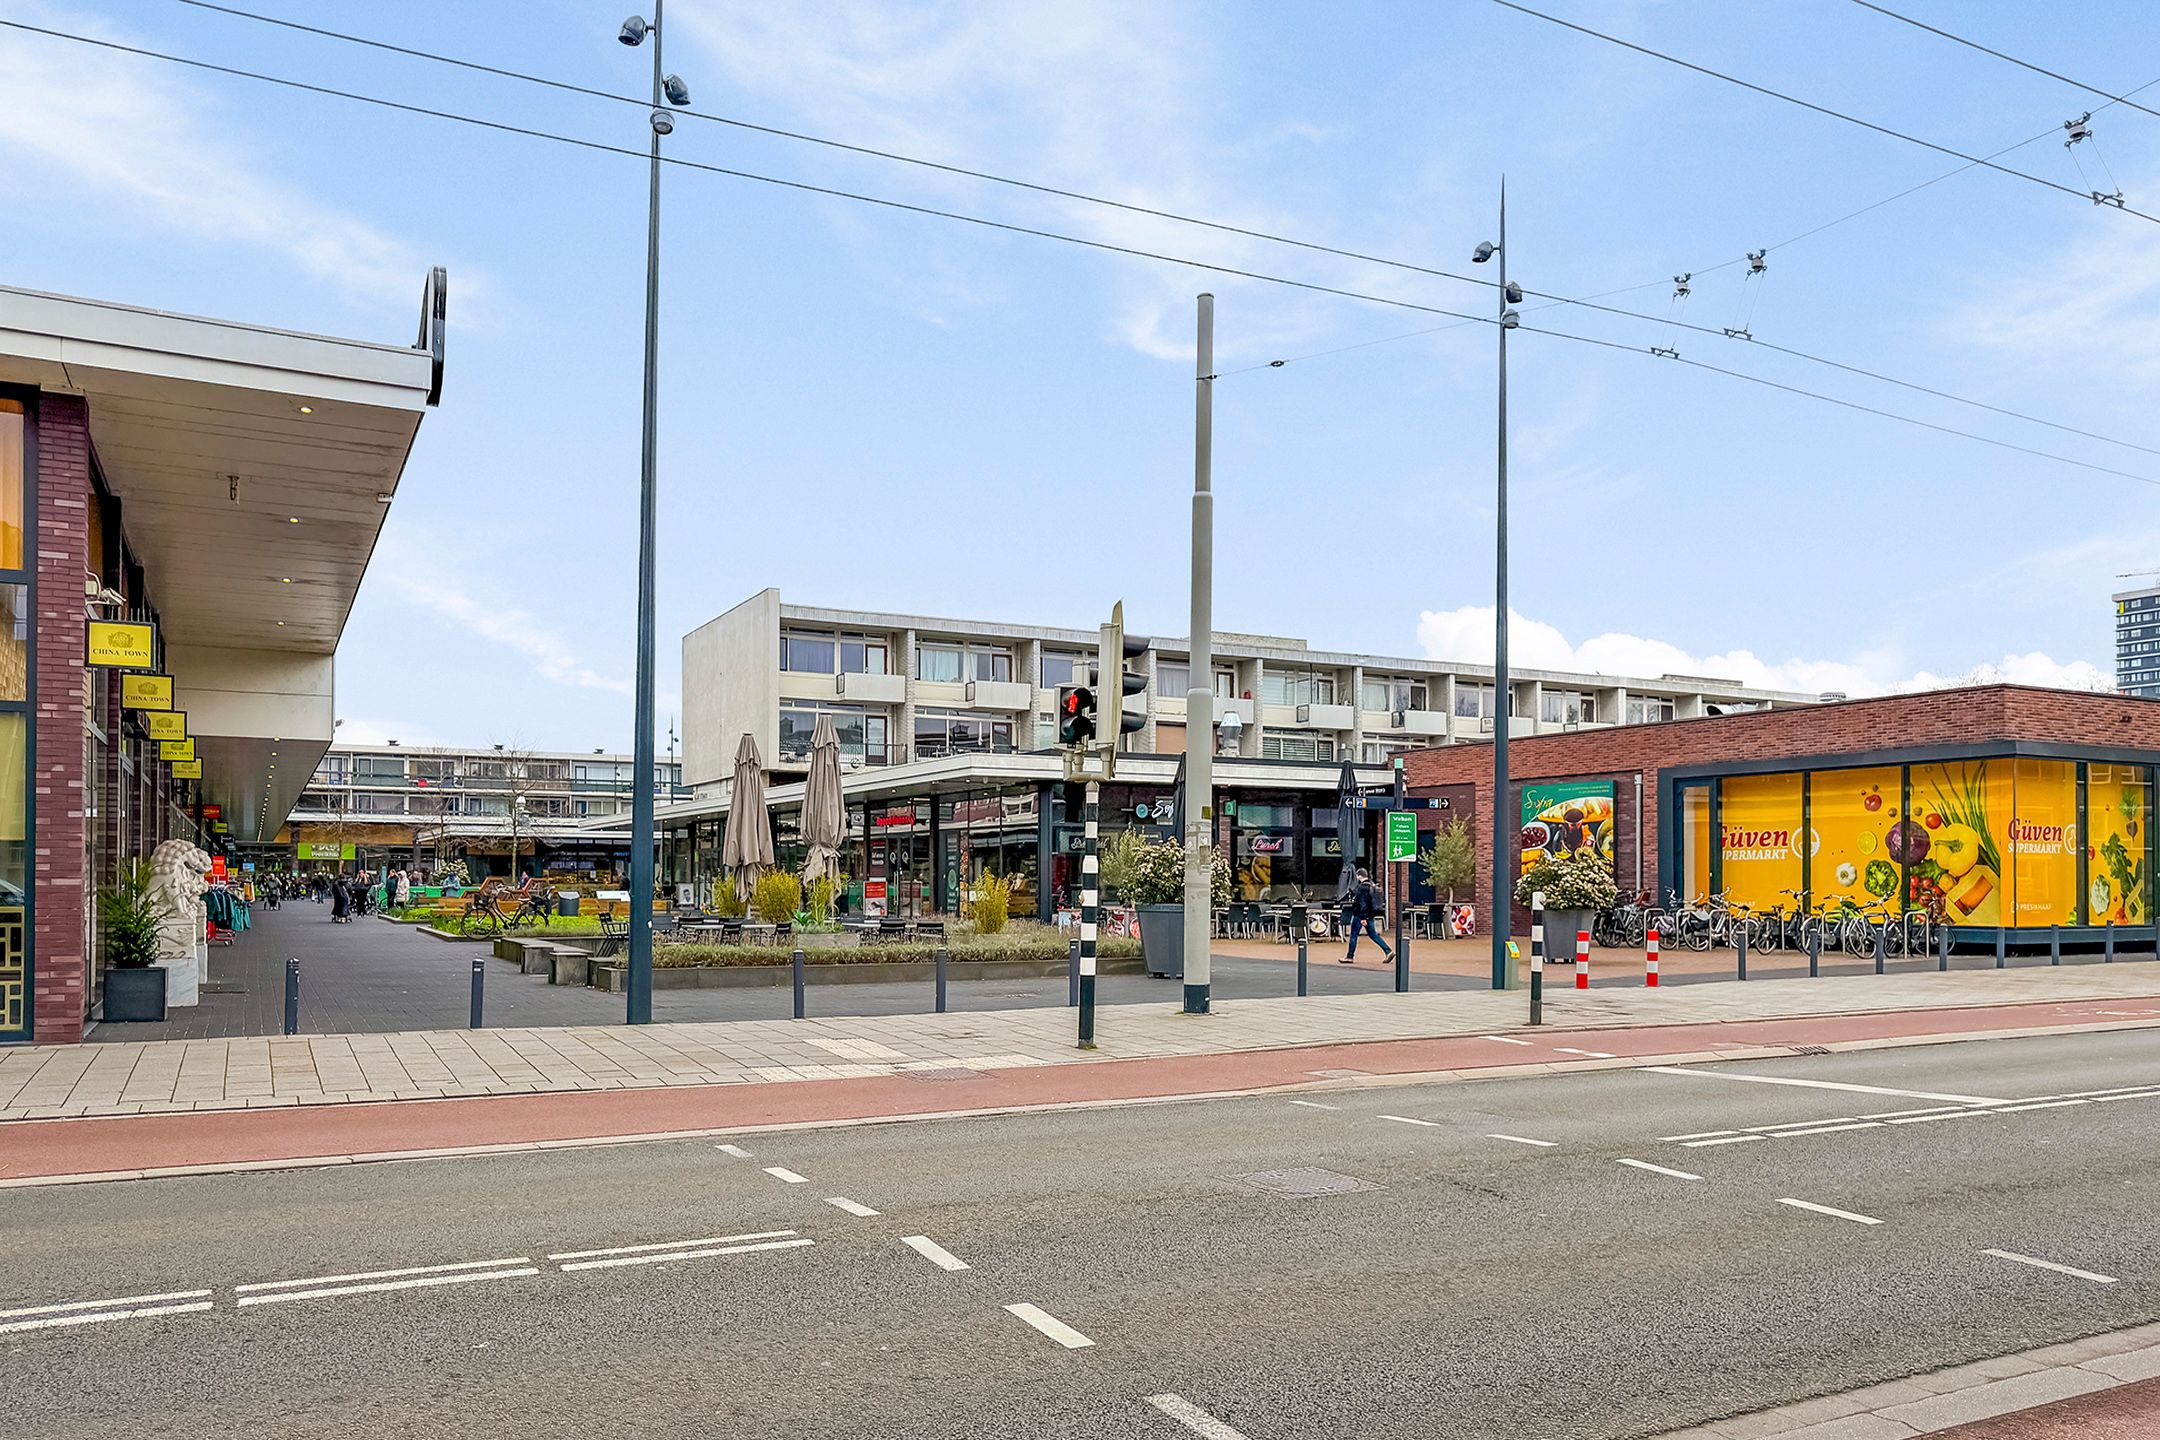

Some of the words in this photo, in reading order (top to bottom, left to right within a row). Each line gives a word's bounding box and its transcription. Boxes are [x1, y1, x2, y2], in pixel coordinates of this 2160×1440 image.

[92, 648, 120, 656] CHINA
[2007, 818, 2063, 842] Güven
[1252, 838, 1283, 851] Lunch
[1722, 849, 1788, 861] PERMARKT
